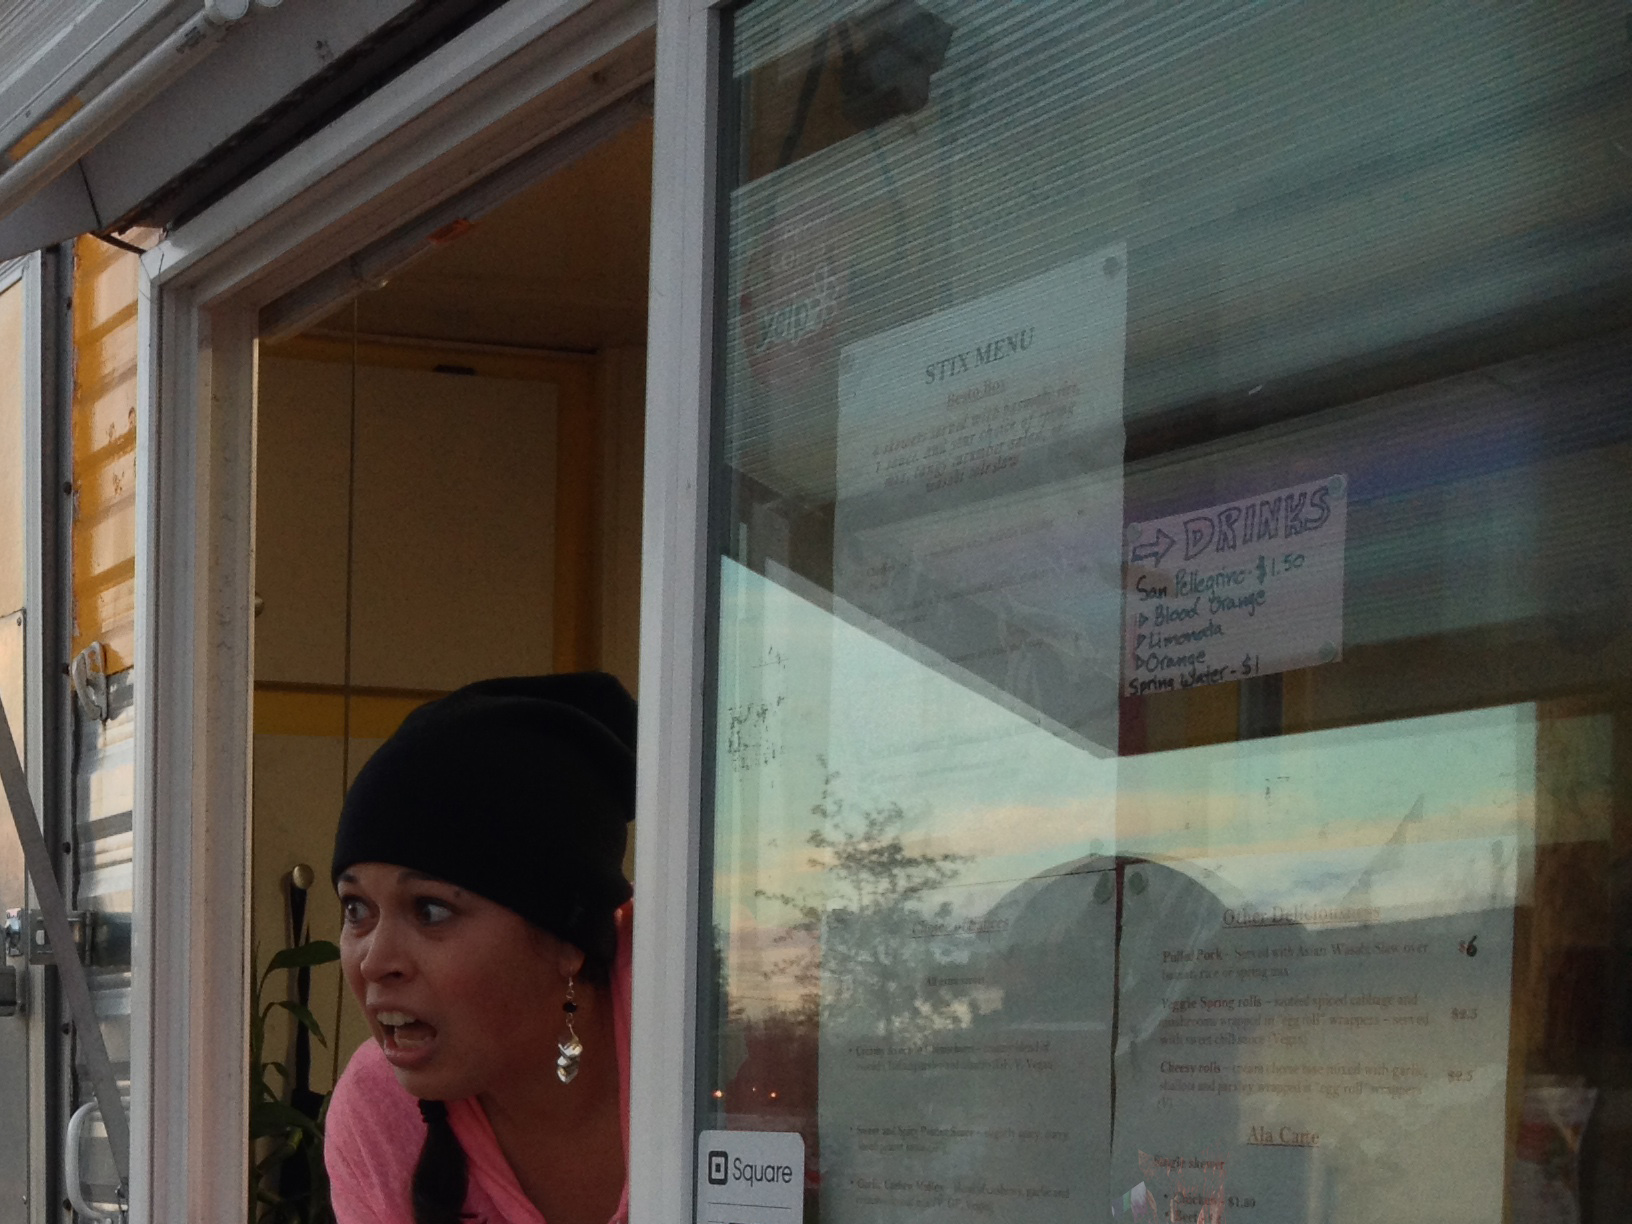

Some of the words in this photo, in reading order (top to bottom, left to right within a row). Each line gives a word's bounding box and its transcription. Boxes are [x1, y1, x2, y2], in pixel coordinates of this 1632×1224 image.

[925, 351, 973, 385] STIX
[975, 326, 1035, 368] MENU
[1183, 485, 1331, 561] DRINKS
[1136, 574, 1168, 601] San
[1256, 553, 1305, 585] $1.50
[1154, 596, 1201, 627] Blood
[1208, 590, 1266, 617] Orange
[1149, 619, 1223, 650] Limonada
[1128, 676, 1174, 696] Spring
[1180, 663, 1228, 688] Water
[1242, 653, 1260, 675] $1
[1146, 650, 1206, 673] Orange
[1199, 996, 1235, 1012] Spring
[1238, 993, 1262, 1008] rolls
[1198, 1061, 1221, 1073] rolls
[1248, 1125, 1273, 1144] Ala
[732, 1157, 792, 1188] Square
